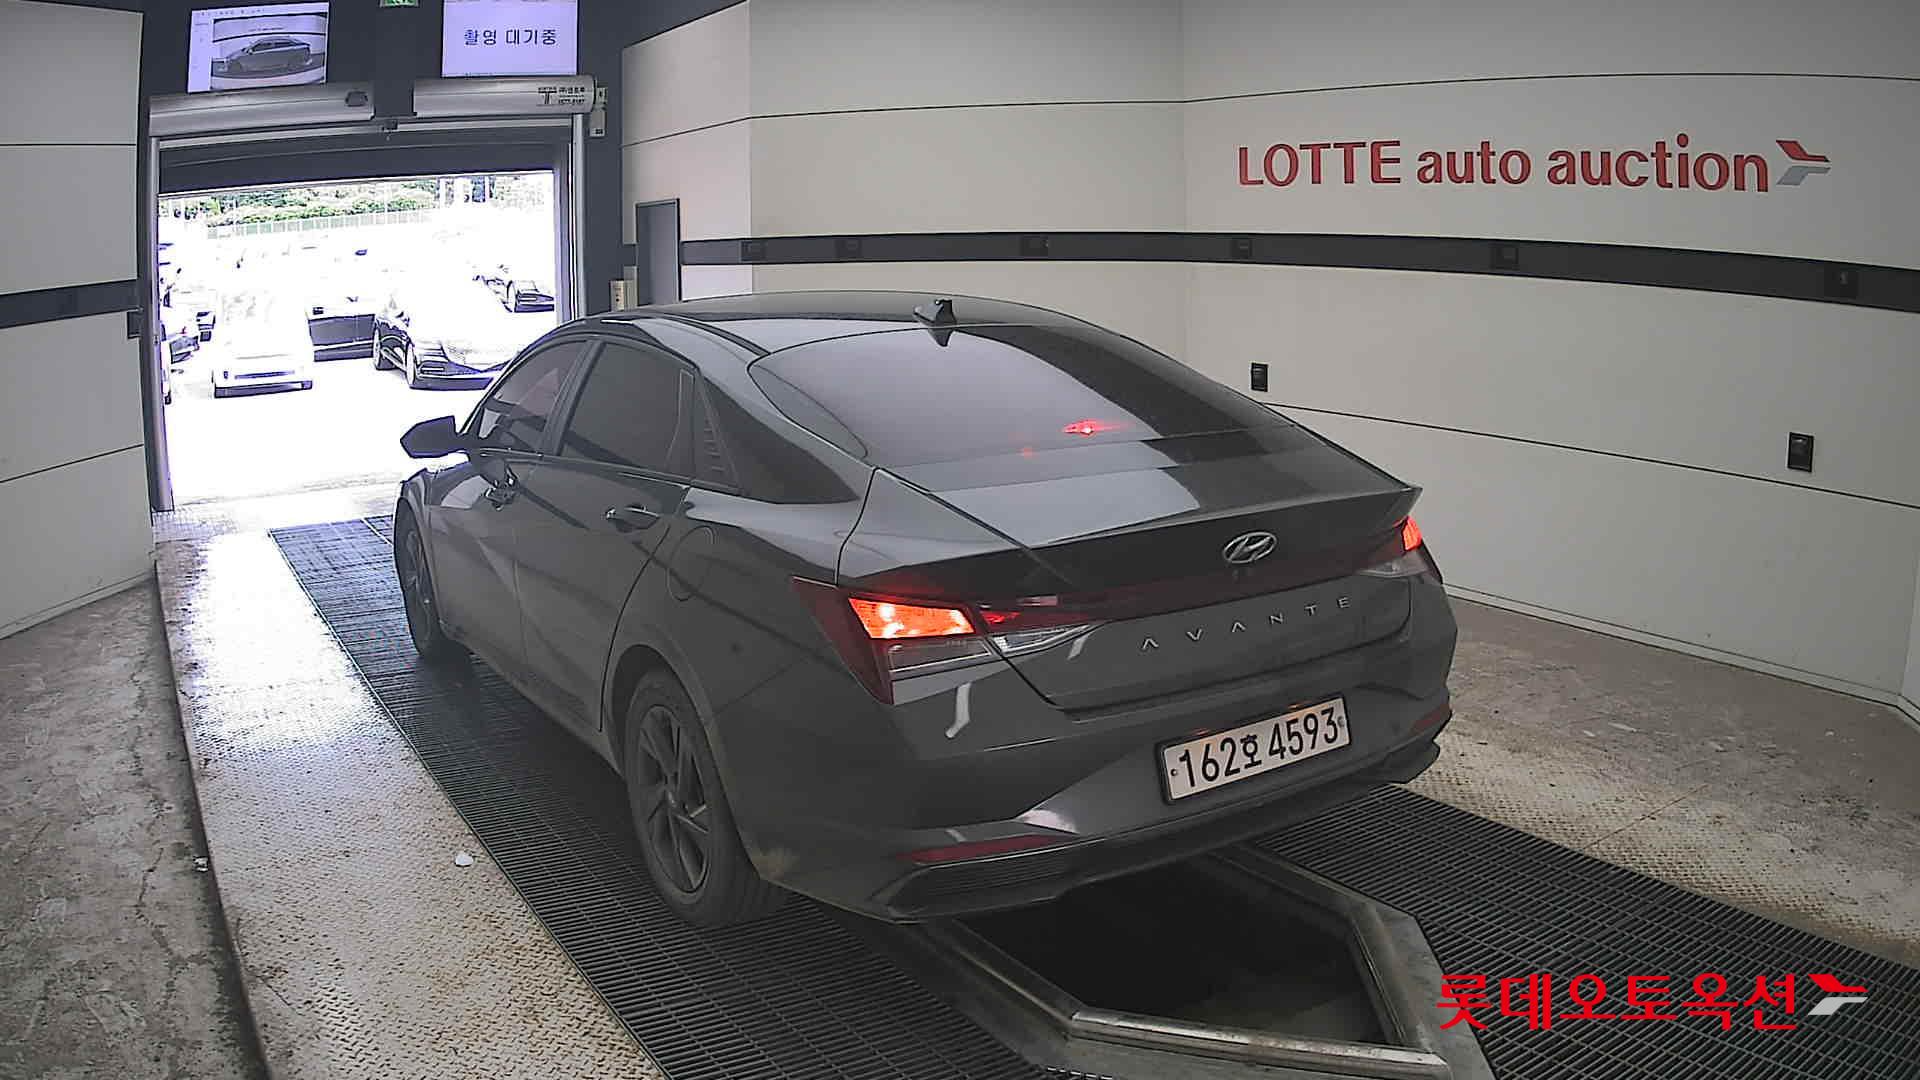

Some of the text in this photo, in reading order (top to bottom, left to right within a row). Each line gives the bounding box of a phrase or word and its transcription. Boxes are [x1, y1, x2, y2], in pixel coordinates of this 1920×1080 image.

[505, 29, 557, 46] 대기중
[1239, 133, 1769, 193] LOTTE auto auction
[1141, 597, 1351, 650] AVANTE
[1178, 707, 1339, 788] 162호 4593
